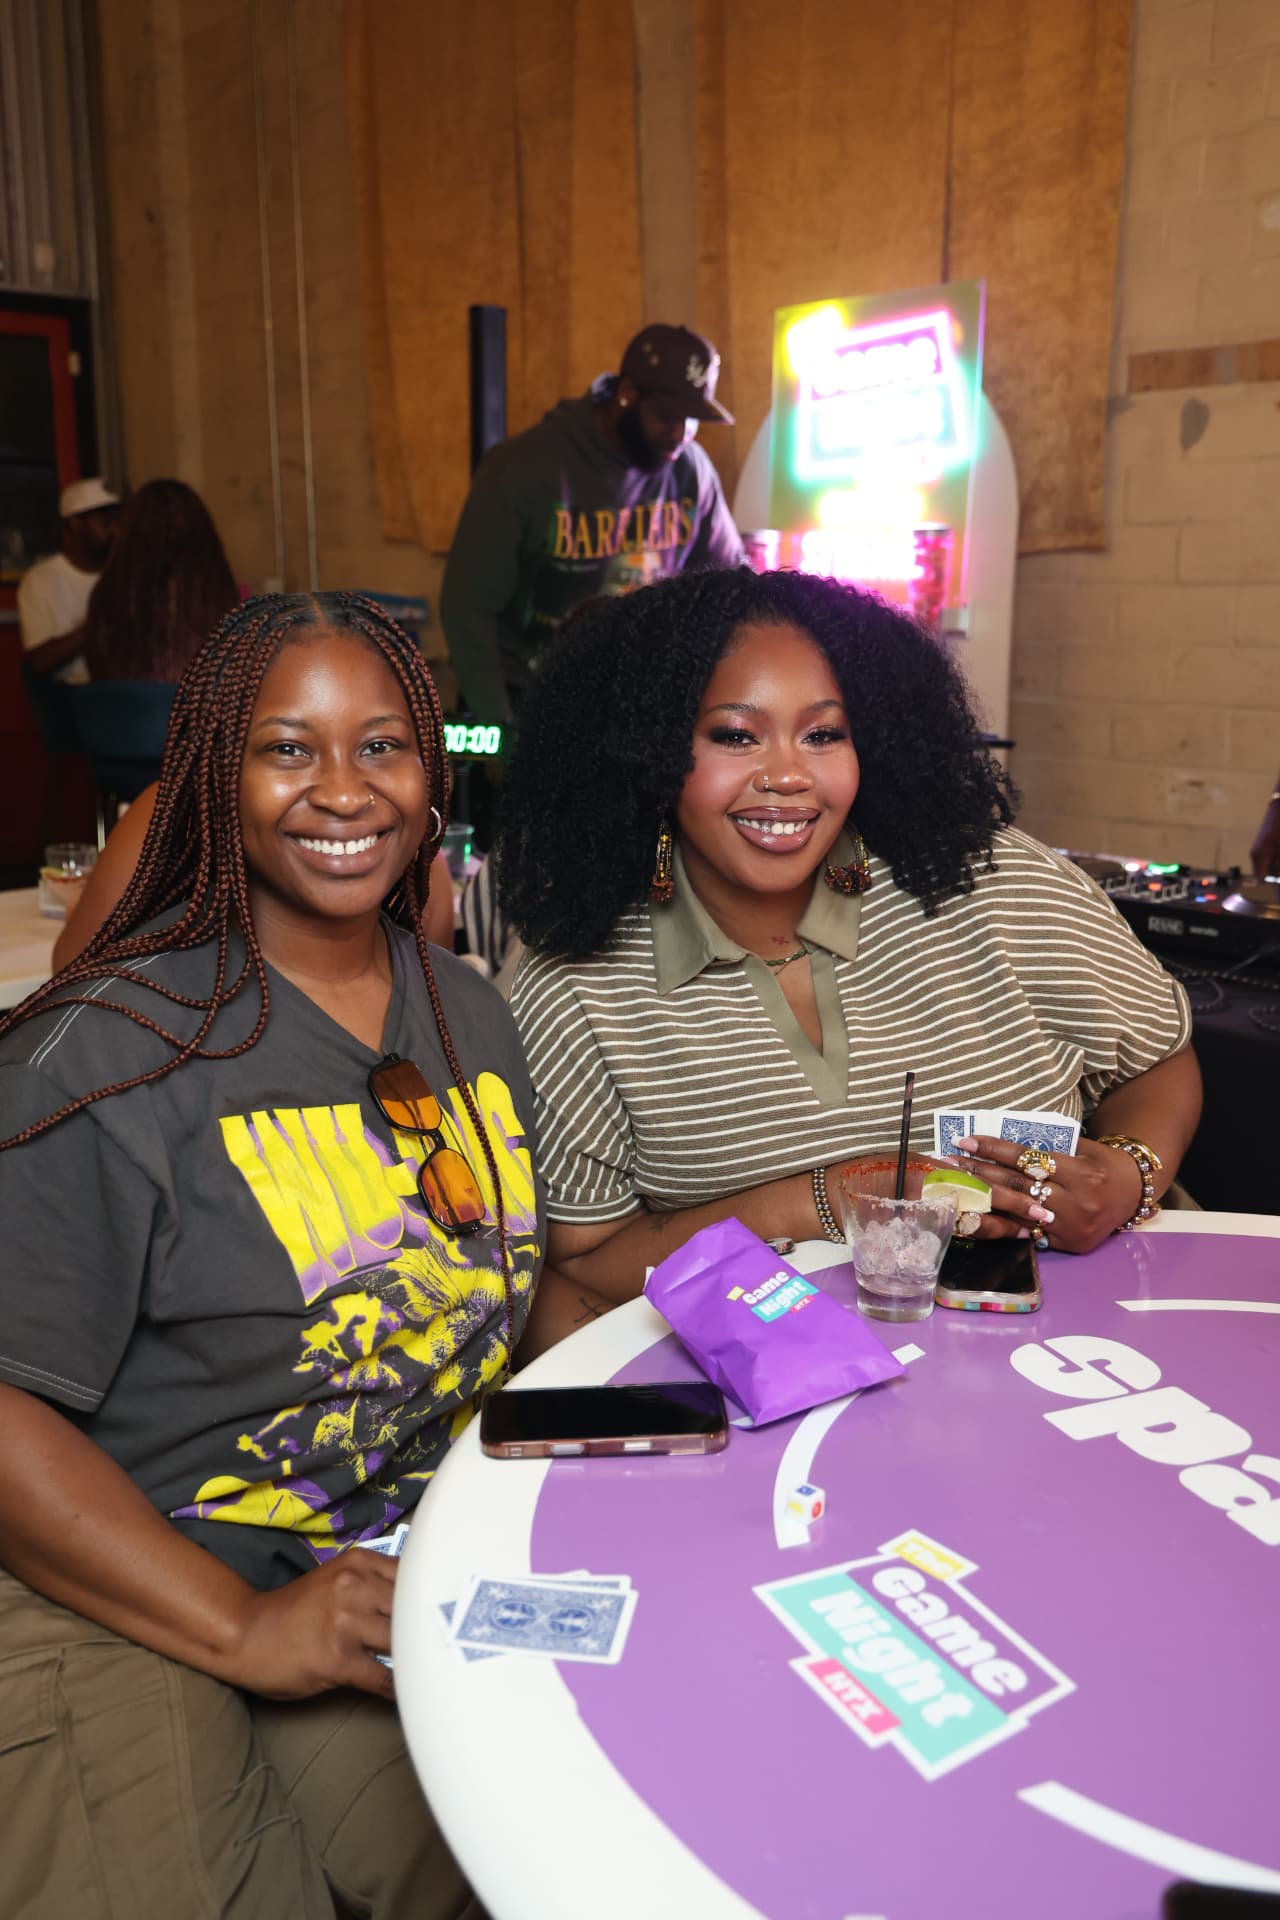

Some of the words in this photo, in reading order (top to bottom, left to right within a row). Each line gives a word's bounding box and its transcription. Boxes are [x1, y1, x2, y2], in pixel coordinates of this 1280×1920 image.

[742, 1272, 790, 1304] Game
[758, 1281, 807, 1316] Night
[872, 1567, 1028, 1695] Game
[809, 1589, 975, 1728] Night
[823, 1671, 883, 1720] HTX
